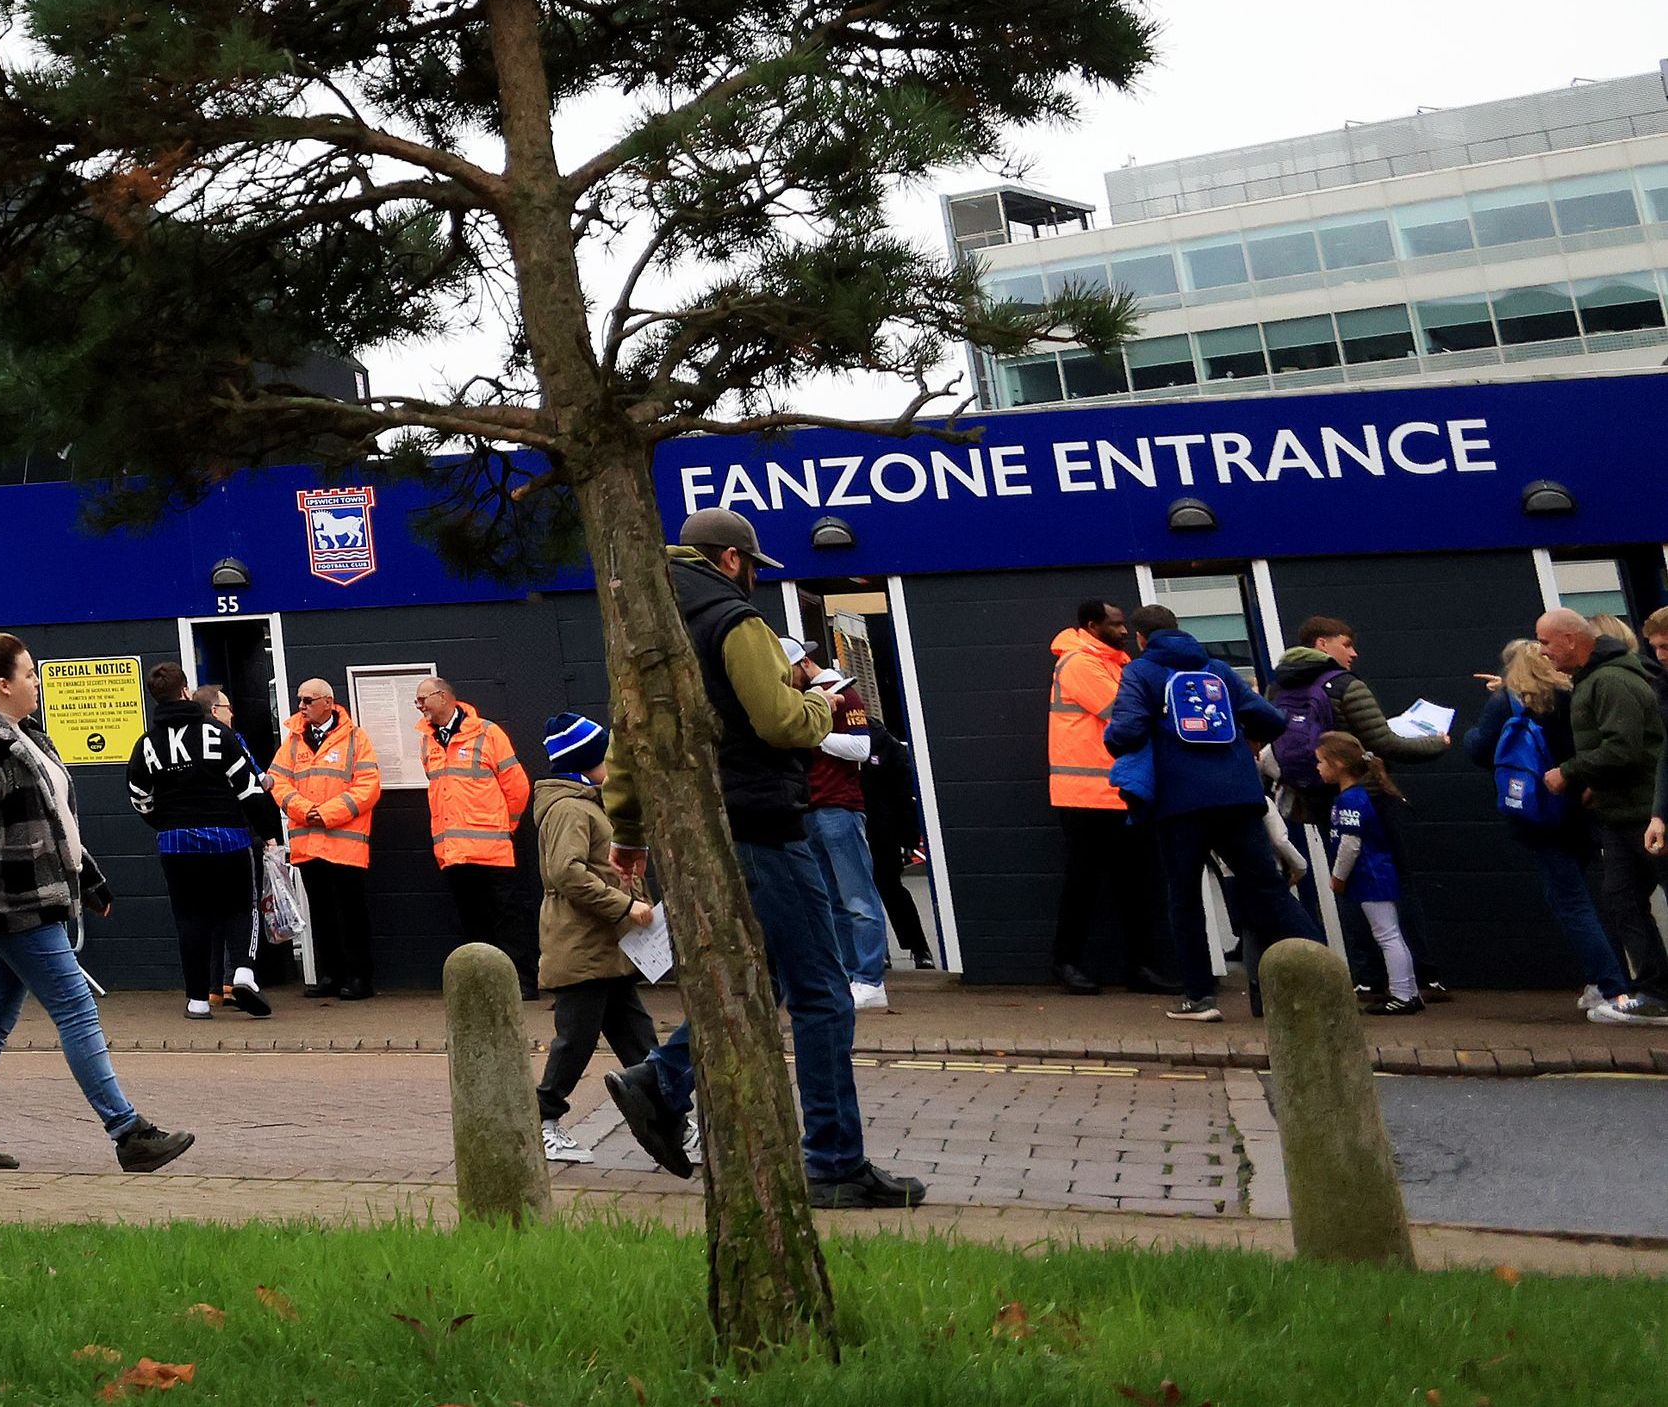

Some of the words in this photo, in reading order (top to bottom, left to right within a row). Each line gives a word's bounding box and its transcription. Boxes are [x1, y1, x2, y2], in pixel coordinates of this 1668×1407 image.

[680, 445, 1033, 514] FANZONE
[1052, 418, 1497, 492] ENTRANCE
[217, 595, 239, 613] 55
[49, 664, 91, 677] SPECIAL
[95, 663, 132, 674] NOTICE
